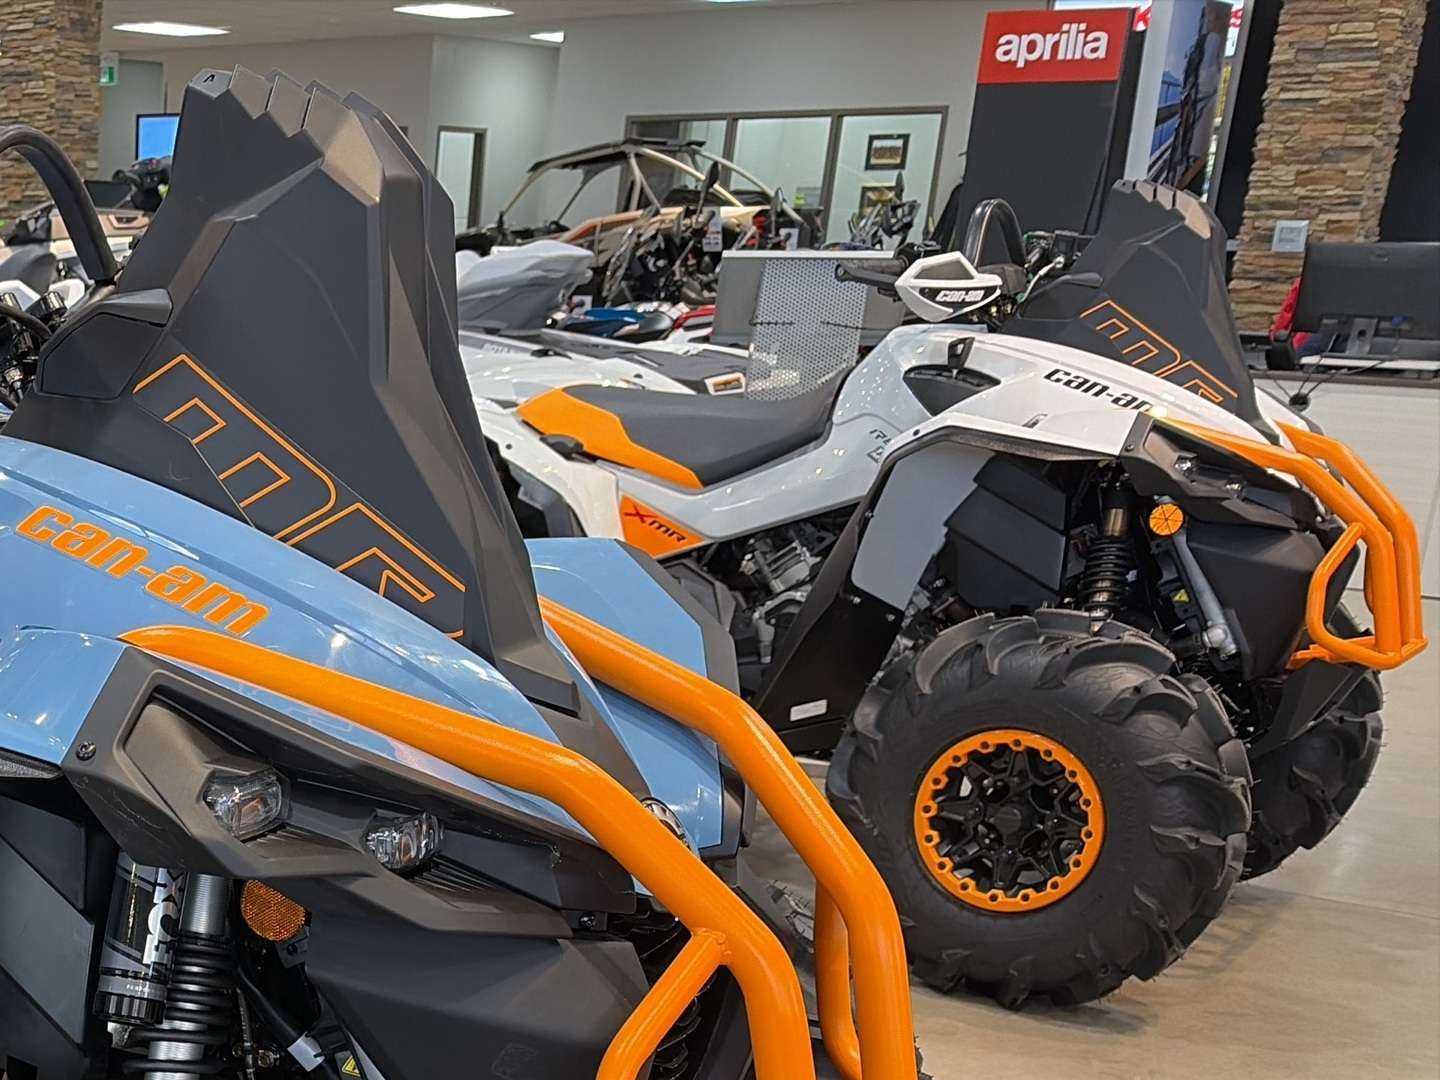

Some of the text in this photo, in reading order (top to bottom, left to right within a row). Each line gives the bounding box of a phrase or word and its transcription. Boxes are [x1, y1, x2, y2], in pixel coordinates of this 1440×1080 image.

[994, 22, 1110, 65] aprilia
[935, 289, 985, 301] can-am
[14, 503, 269, 637] can-am
